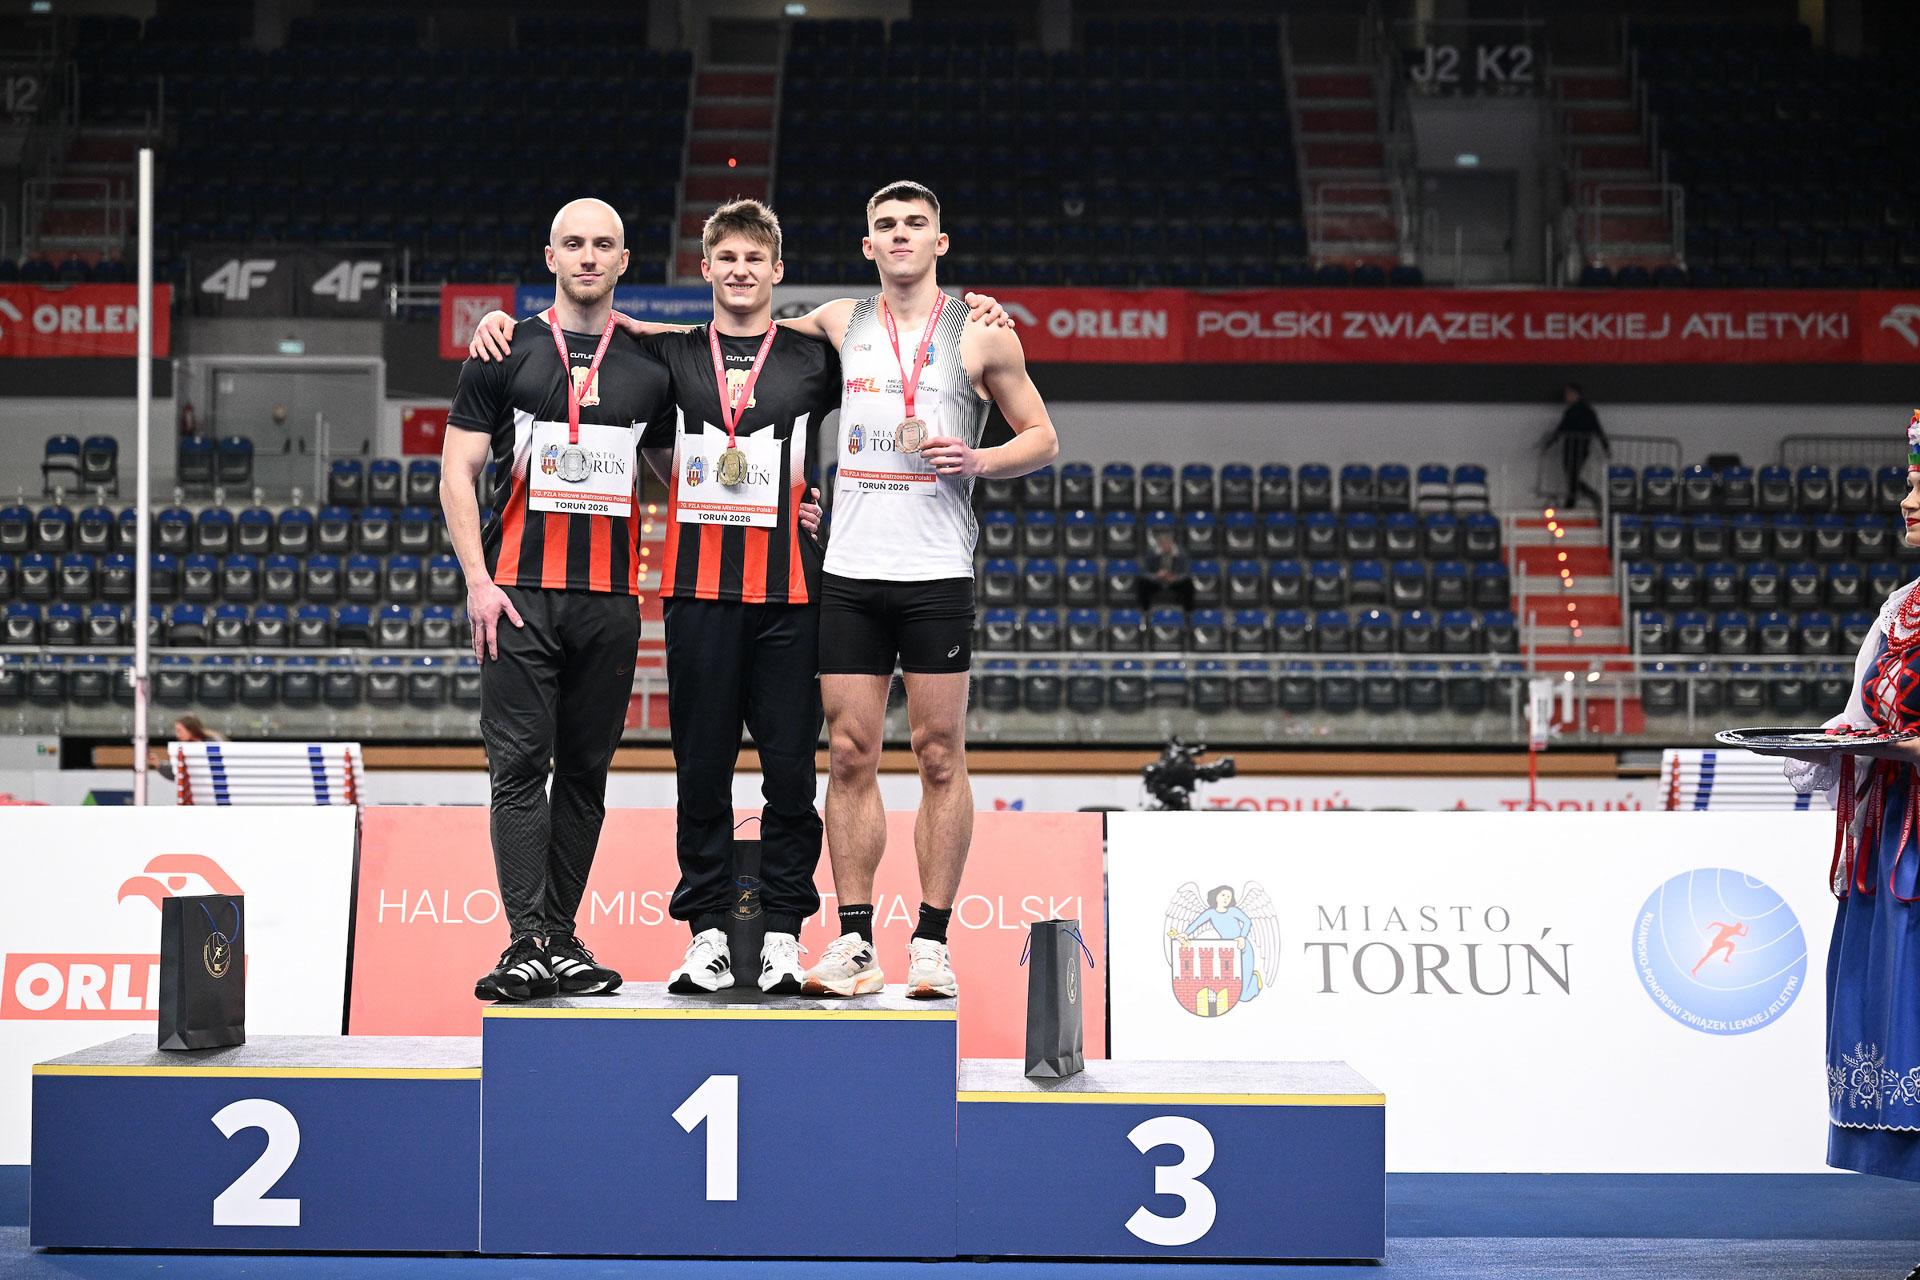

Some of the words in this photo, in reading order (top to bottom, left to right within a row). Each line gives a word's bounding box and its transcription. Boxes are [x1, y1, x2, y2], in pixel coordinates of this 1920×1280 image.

[1411, 47, 1459, 81] J2
[1477, 47, 1533, 81] K2
[202, 259, 276, 300] 4F
[312, 260, 382, 302] 4F
[1047, 309, 1167, 338] ORLEN
[1197, 311, 1331, 338] POLSKI
[1342, 311, 1513, 343] ZWIĄZEK
[1523, 312, 1670, 339] LEKKIEJ
[1681, 312, 1848, 339] ATLETYKI
[846, 378, 880, 394] MKL
[555, 501, 586, 510] TORUŃ
[588, 504, 609, 512] 2026
[858, 481, 887, 490] TORUŃ
[888, 483, 910, 491] 2026
[698, 512, 728, 522] TORUŃ
[729, 515, 751, 523] 2026
[378, 889, 500, 924] HALO
[954, 895, 1083, 930] OLSKI
[1316, 905, 1511, 933] MIASTO
[1303, 927, 1574, 996] TORUŃ
[1637, 911, 1682, 1016] KUJAWSKO-POMORSKI
[1681, 1010, 1729, 1032] ZWIĄZEK
[1729, 1010, 1770, 1031] LEKKIEJ
[1769, 975, 1799, 1016] ATLETYKI
[15, 962, 160, 1011] ORL
[671, 1075, 738, 1201] 1
[210, 1098, 300, 1227] 2
[1124, 1116, 1217, 1246] 3
